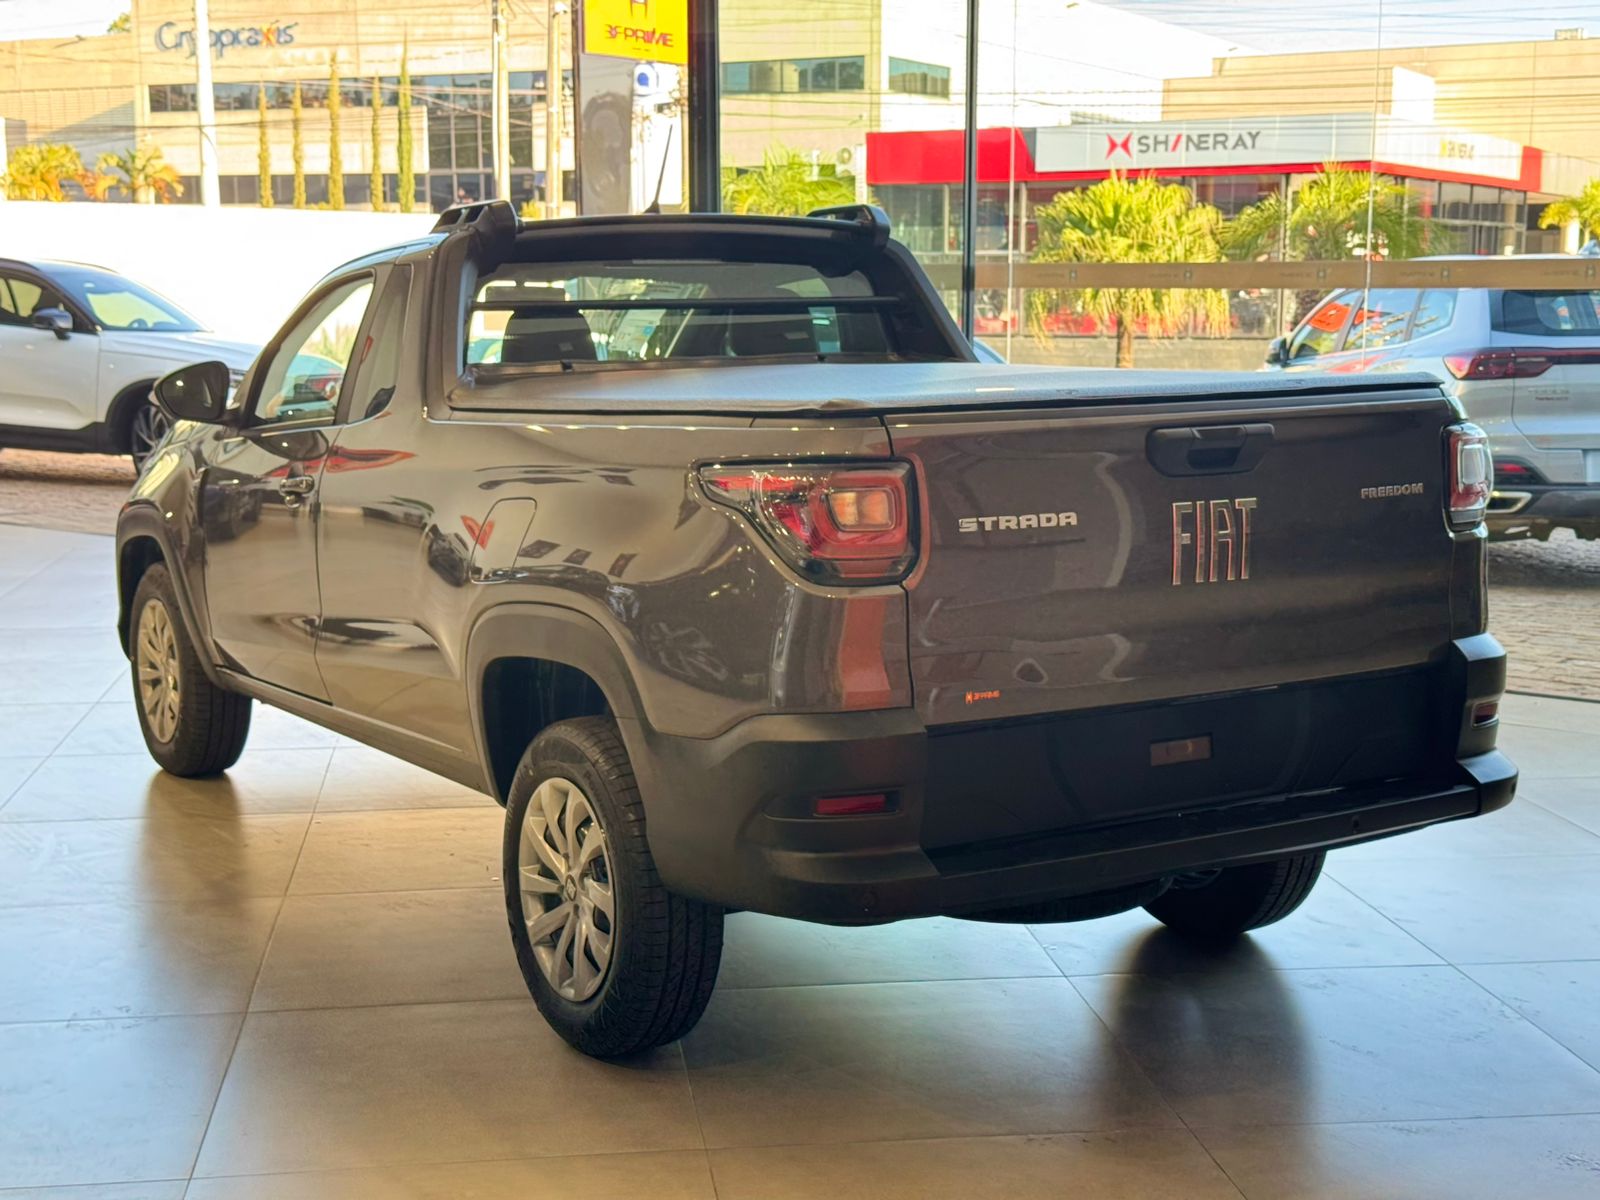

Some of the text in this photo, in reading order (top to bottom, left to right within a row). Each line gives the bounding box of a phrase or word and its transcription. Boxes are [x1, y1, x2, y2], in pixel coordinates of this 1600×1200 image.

[1360, 482, 1424, 499] FREEDOM
[958, 511, 1078, 533] STRADA
[1171, 497, 1257, 586] FIAT
